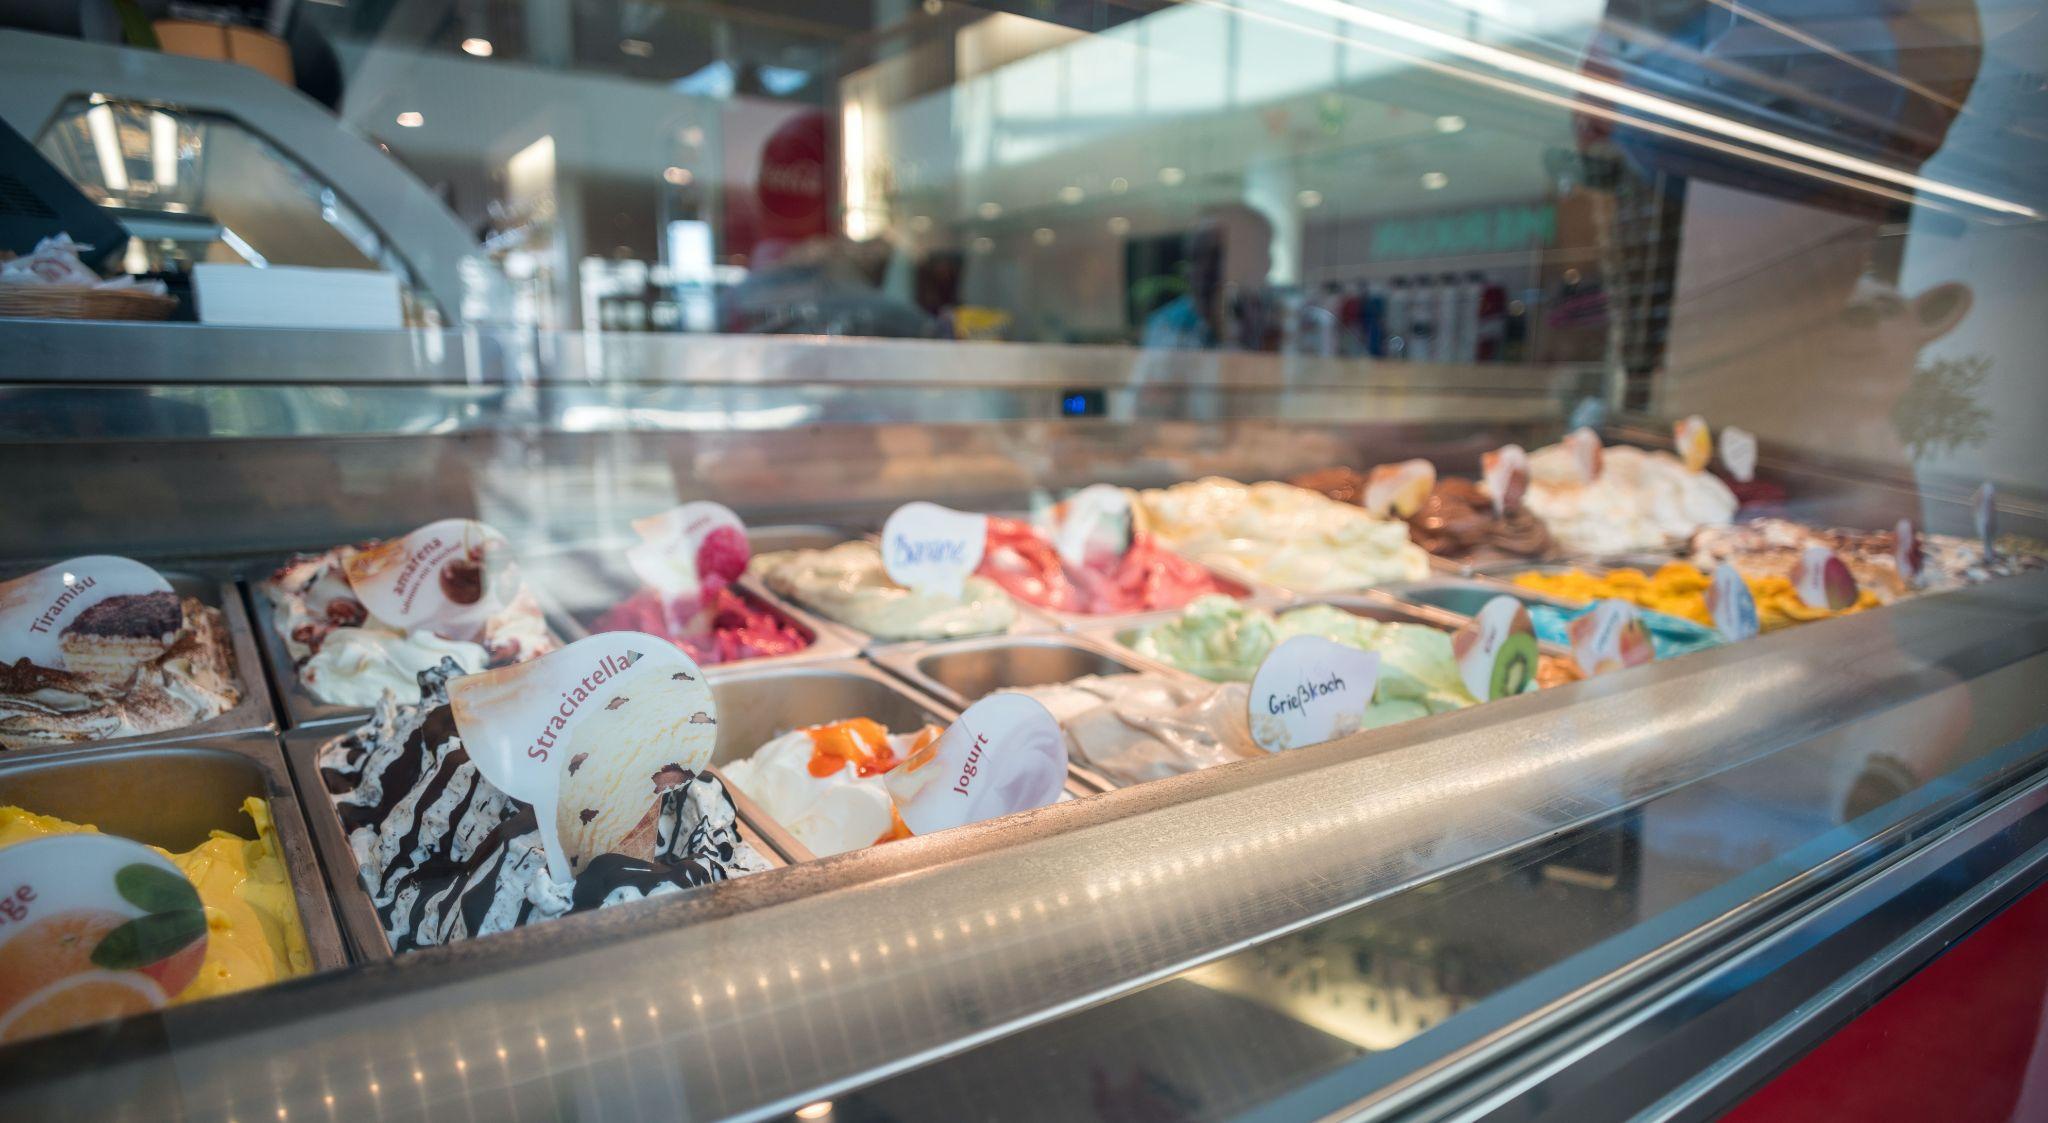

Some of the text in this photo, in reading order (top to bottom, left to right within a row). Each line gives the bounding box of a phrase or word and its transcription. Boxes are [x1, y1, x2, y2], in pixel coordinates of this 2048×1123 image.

[393, 537, 443, 595] amarena
[29, 575, 97, 633] Tiramisu
[527, 654, 632, 763] Straciatella
[1268, 671, 1346, 717] Grießkoch
[953, 731, 989, 797] Jogurt
[0, 885, 38, 924] ge
